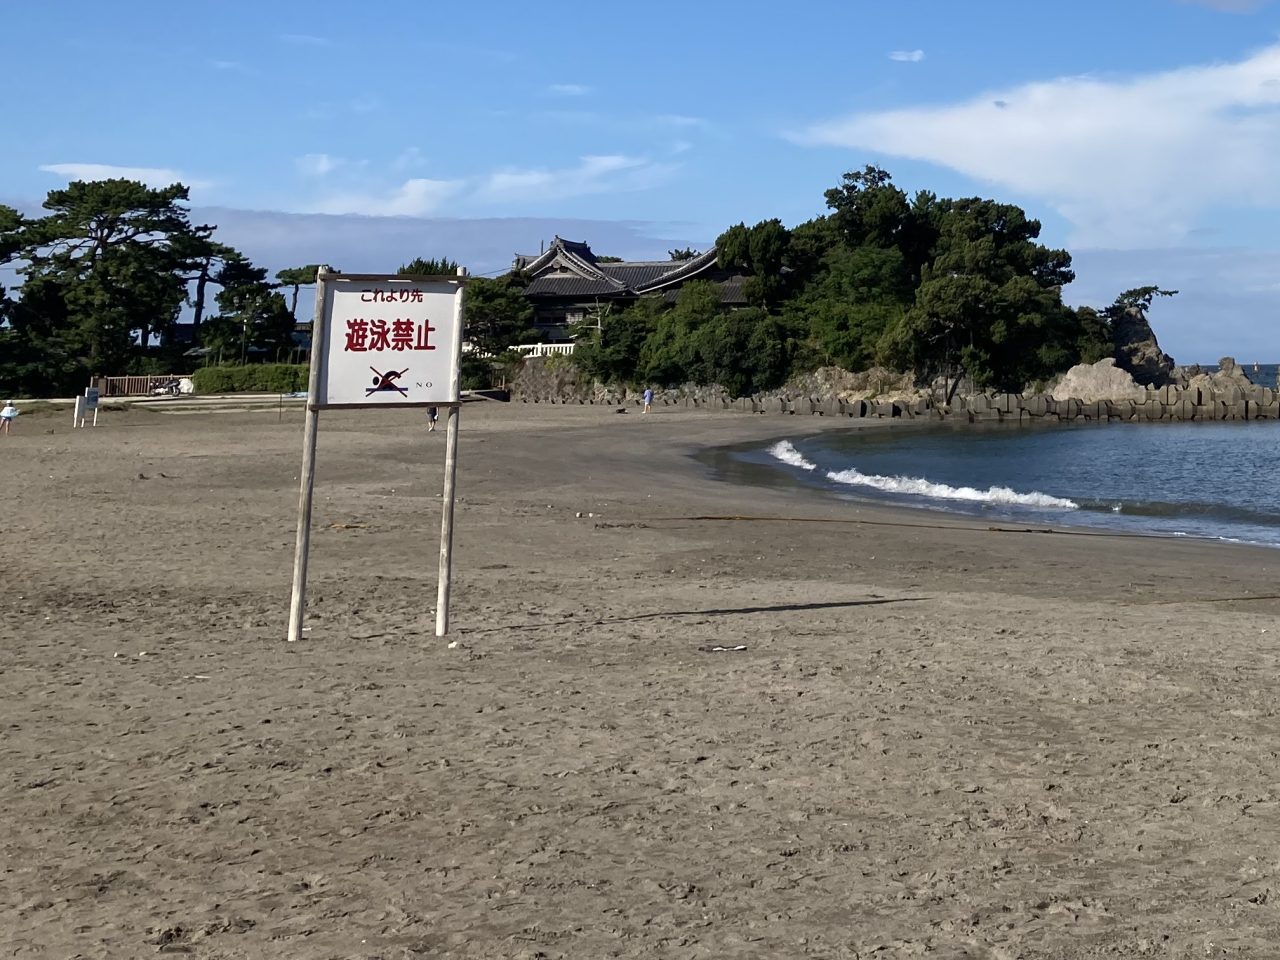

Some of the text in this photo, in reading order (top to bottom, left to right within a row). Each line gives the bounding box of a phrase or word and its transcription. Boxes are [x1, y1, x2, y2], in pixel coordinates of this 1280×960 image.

[361, 288, 423, 303] これより先
[344, 318, 436, 352] 遊泳禁止
